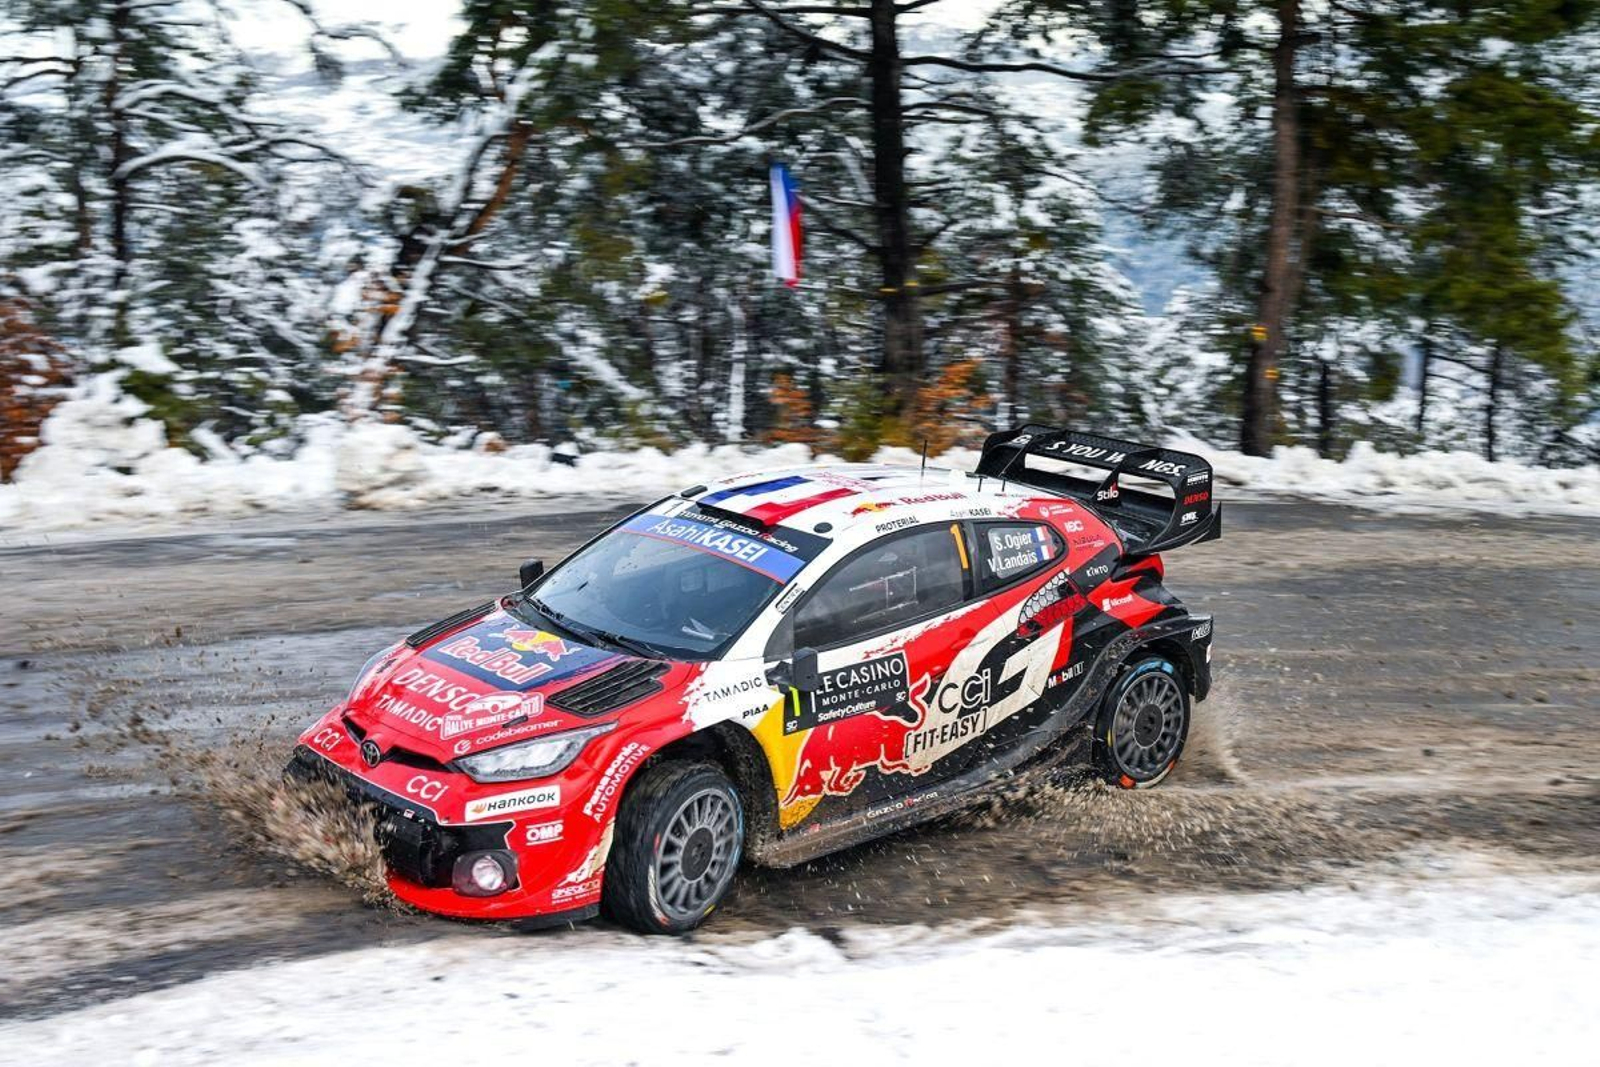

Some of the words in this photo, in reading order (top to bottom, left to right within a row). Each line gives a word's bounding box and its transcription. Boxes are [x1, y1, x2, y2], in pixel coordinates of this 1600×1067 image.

[1063, 443, 1107, 459] YOU
[1096, 482, 1119, 501] Stilo
[875, 515, 920, 533] PROTERIAL
[951, 524, 967, 570] 1
[836, 657, 904, 690] CASINO
[391, 668, 482, 713] DENSO
[703, 676, 763, 704] TAMADIC
[375, 693, 441, 732] TAMADIC
[742, 703, 770, 720] PIAA
[476, 719, 562, 746] codebeamer
[582, 742, 639, 818] Panasonic
[592, 744, 651, 824] AUTOMOTIVE
[525, 822, 565, 843] OMP
